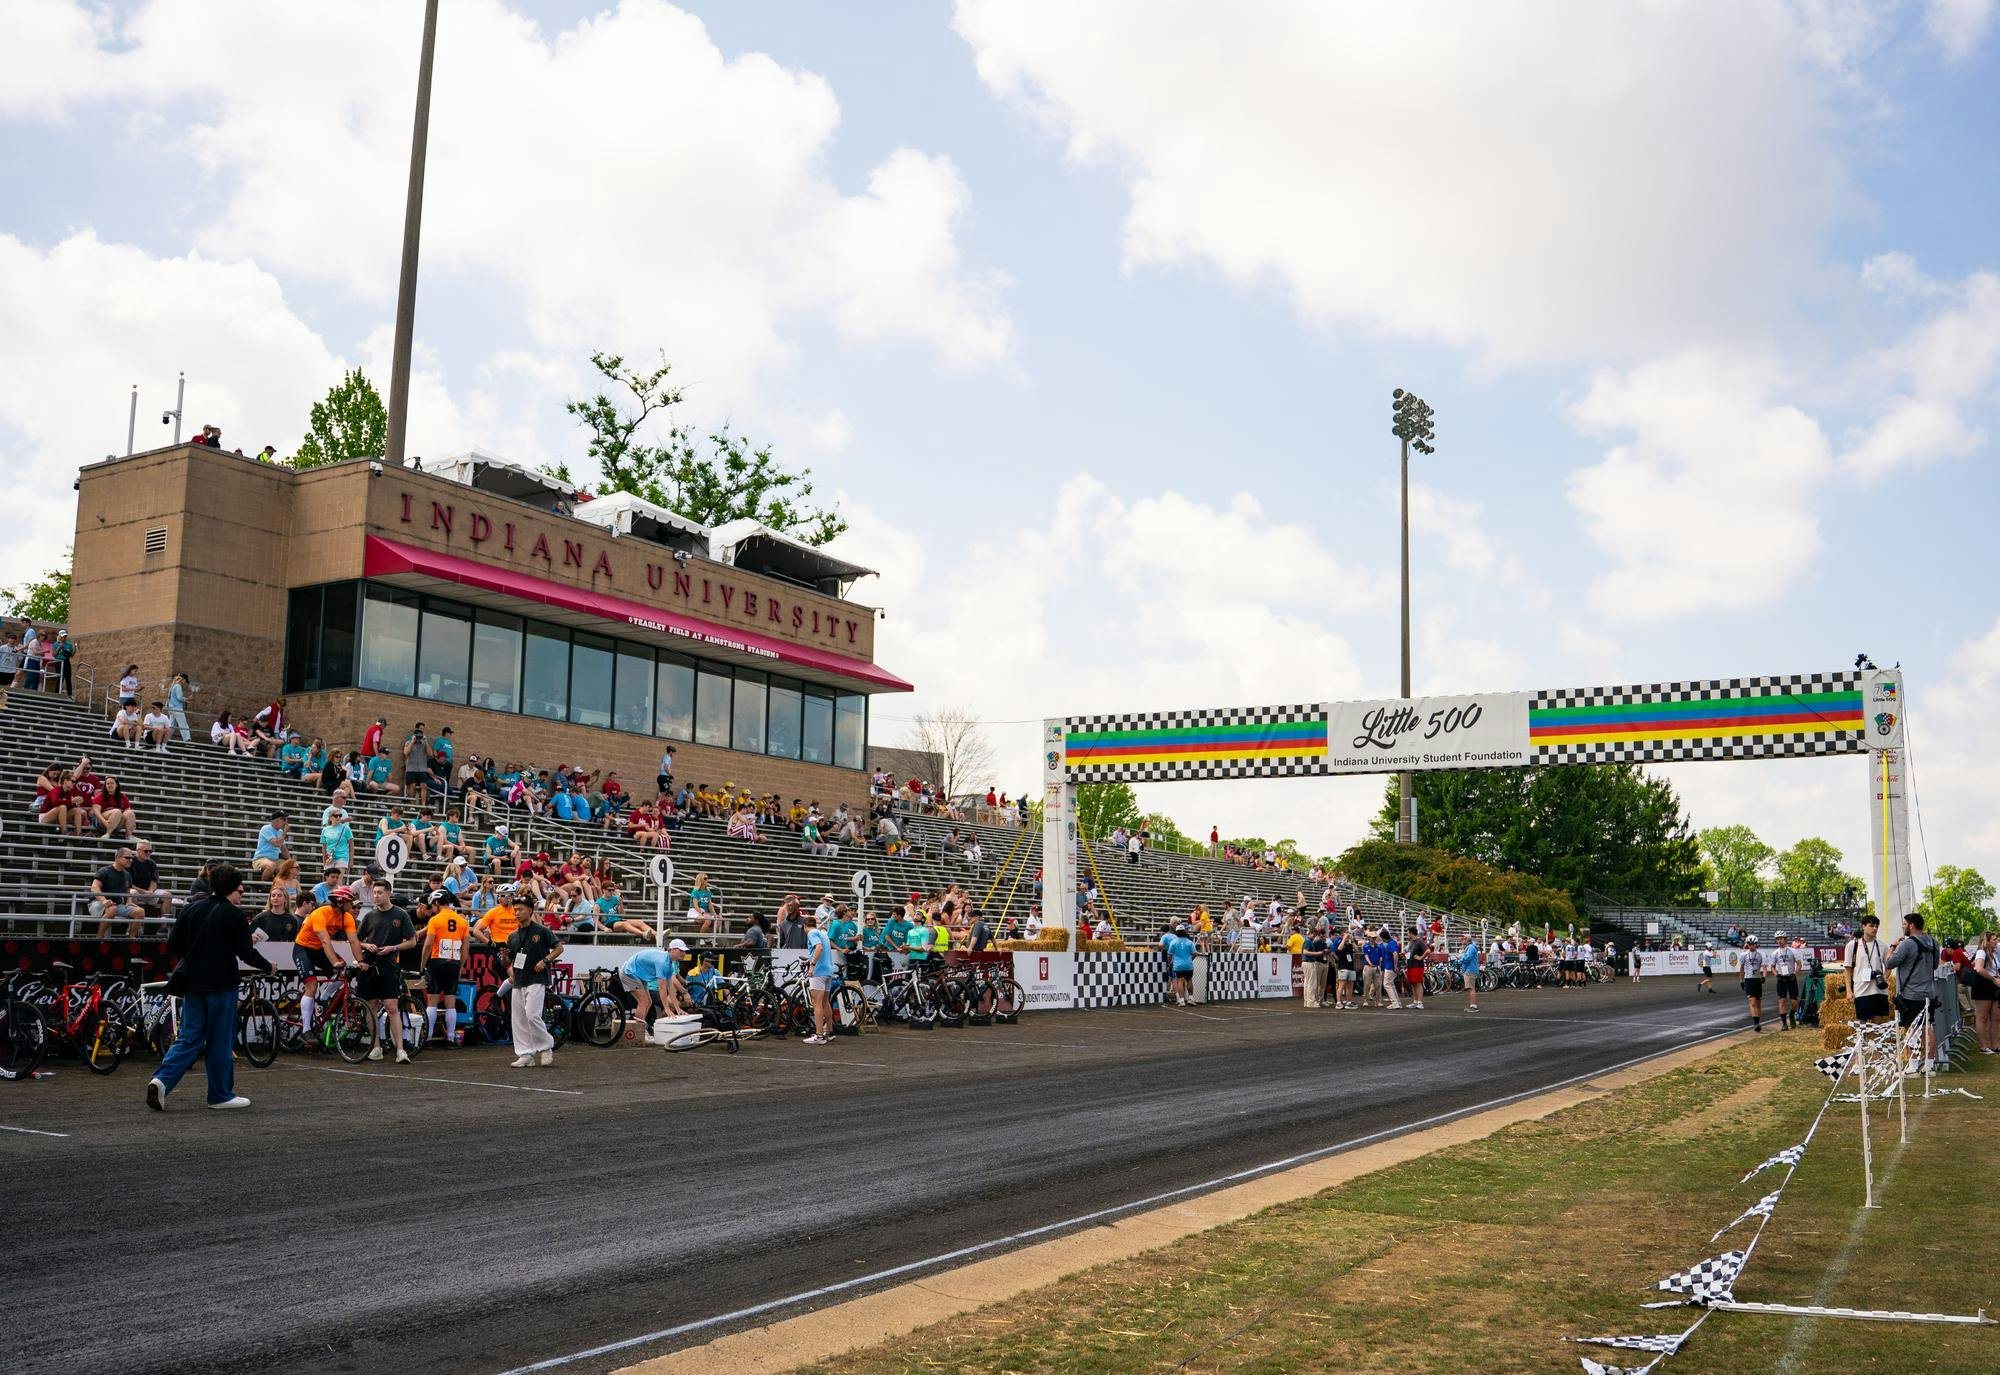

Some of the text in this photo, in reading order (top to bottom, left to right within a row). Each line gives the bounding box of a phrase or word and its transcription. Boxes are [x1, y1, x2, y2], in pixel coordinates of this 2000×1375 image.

[401, 493, 858, 642] INDIANA UNIVERSITY
[633, 617, 776, 659] YEAGLEY FIELD AT ARMSTRONG STADIUM
[1353, 703, 1482, 749] Little 500
[1334, 750, 1522, 767] Indiana University Student Foundation
[385, 839, 401, 869] 8
[658, 858, 667, 883] 9
[857, 874, 867, 894] 4
[1041, 992, 1071, 1003] FOUNDATION
